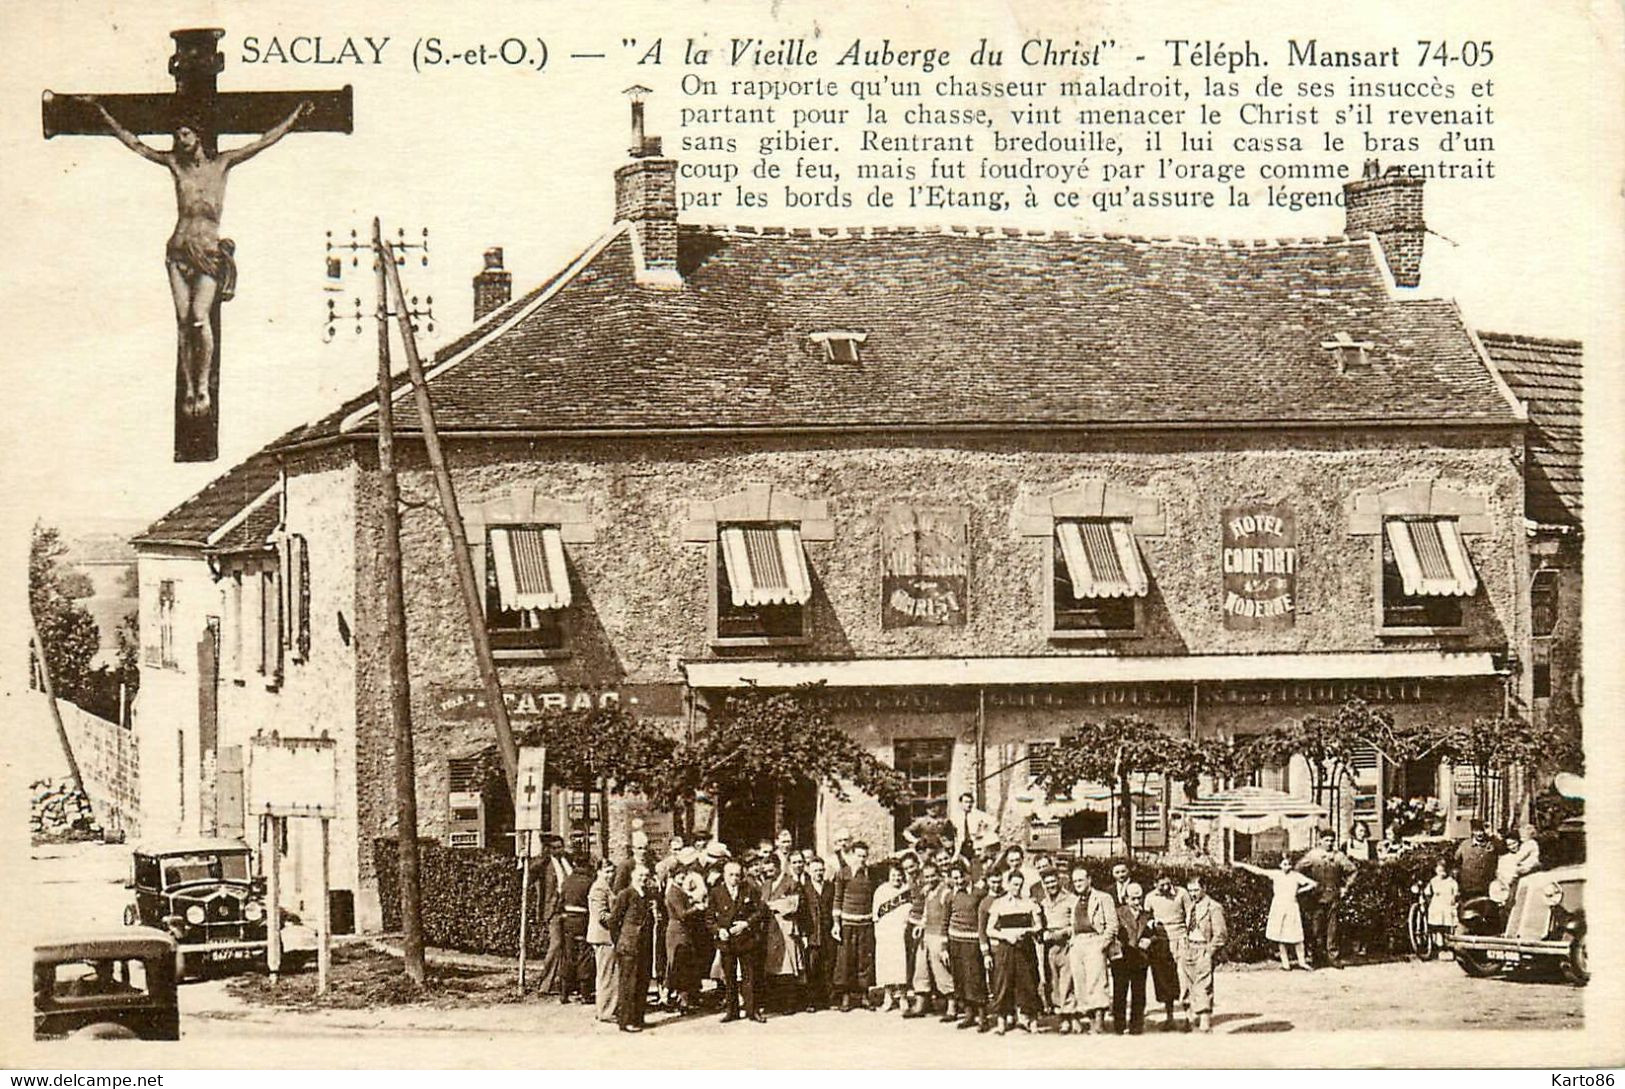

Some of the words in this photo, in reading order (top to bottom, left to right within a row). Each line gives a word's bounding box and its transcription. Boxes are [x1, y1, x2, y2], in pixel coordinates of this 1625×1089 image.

[1228, 515, 1284, 540] HOTEL
[1223, 547, 1296, 574] CONFORT
[1224, 591, 1295, 618] MODERNE
